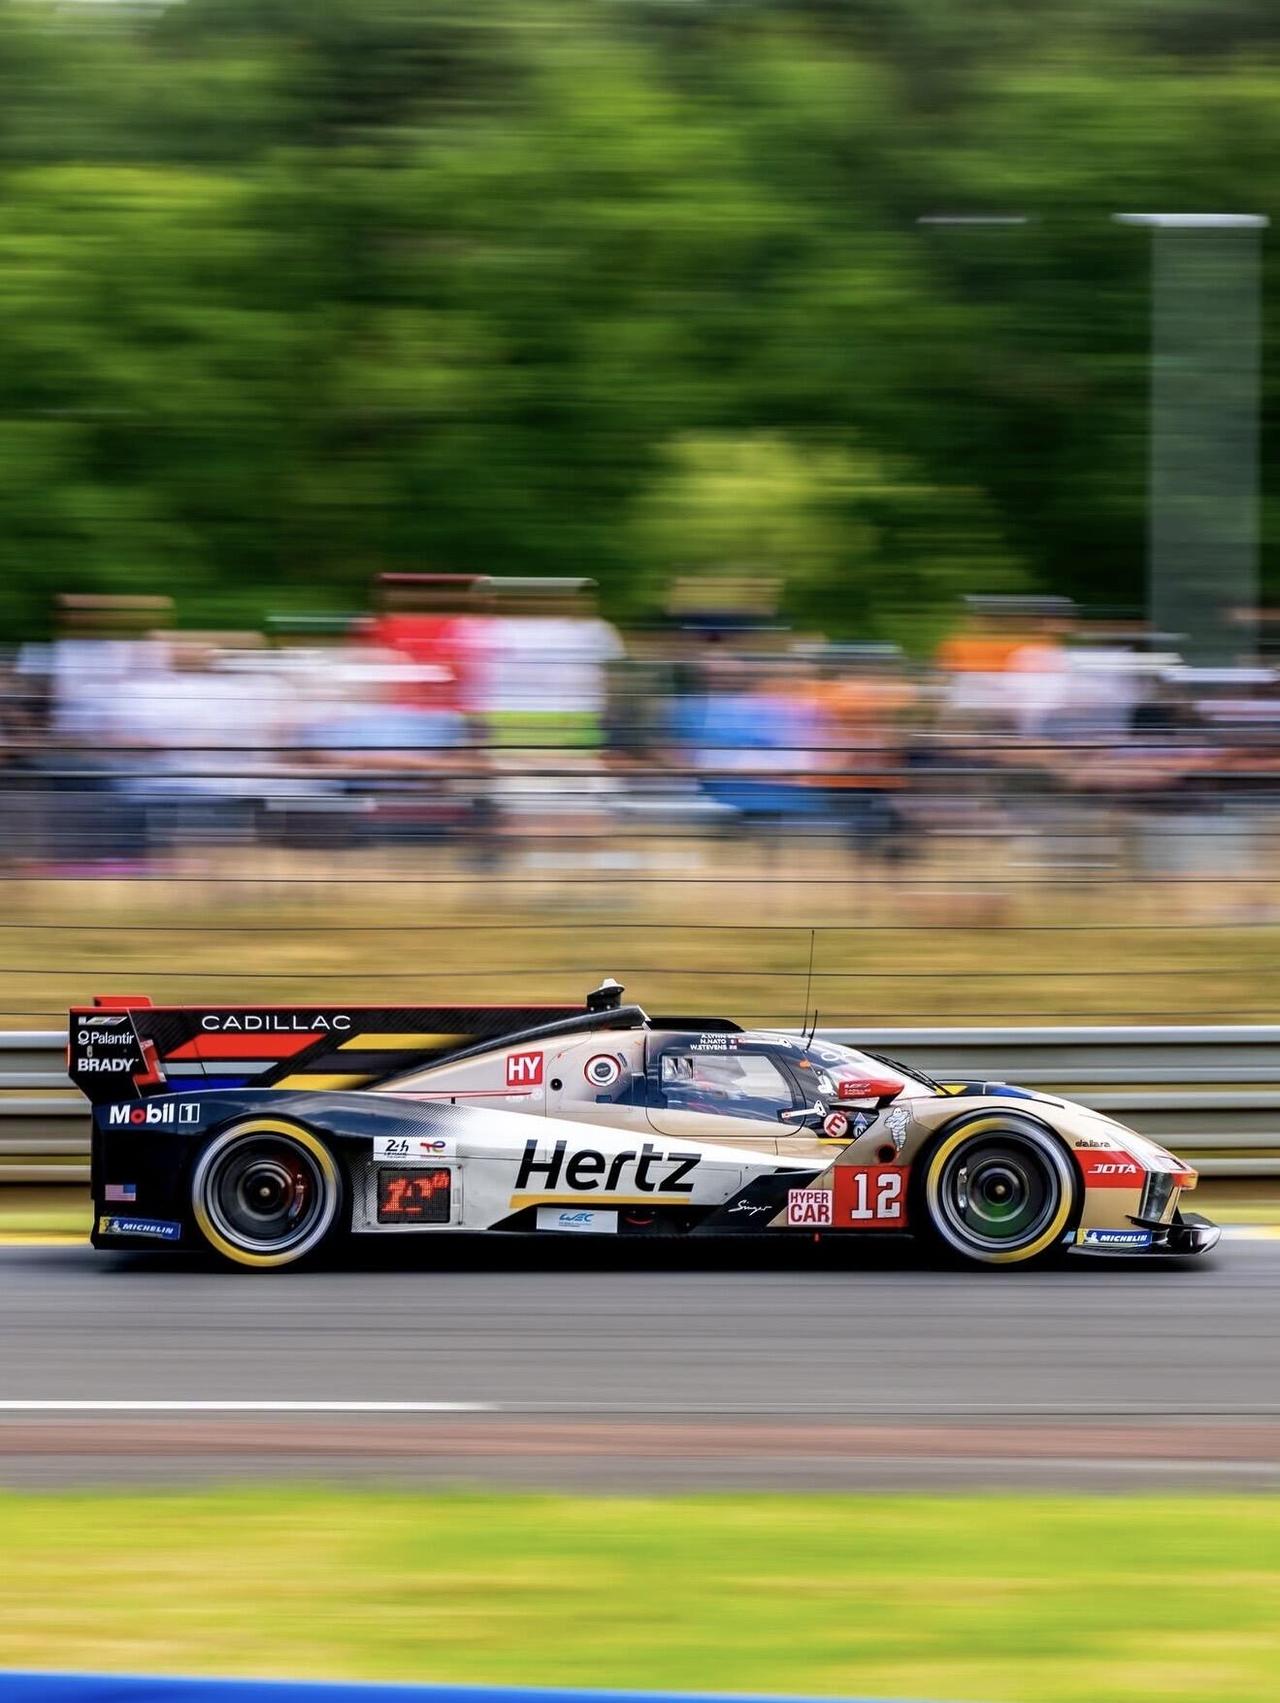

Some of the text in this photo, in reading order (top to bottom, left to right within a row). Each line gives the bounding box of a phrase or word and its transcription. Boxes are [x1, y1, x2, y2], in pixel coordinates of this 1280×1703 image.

[201, 1015, 351, 1030] CADILLAC
[91, 1031, 135, 1045] Palantir
[78, 1058, 134, 1072] BRADY
[508, 1056, 541, 1081] HY
[109, 1103, 175, 1124] Mobil
[514, 1139, 702, 1192] Hertz
[1087, 1163, 1137, 1174] JOTA
[790, 1192, 829, 1204] HYPER
[851, 1173, 901, 1220] 12
[790, 1203, 830, 1223] CAR
[122, 1223, 174, 1235] MICHELIN
[1100, 1234, 1148, 1243] MICHELIN
